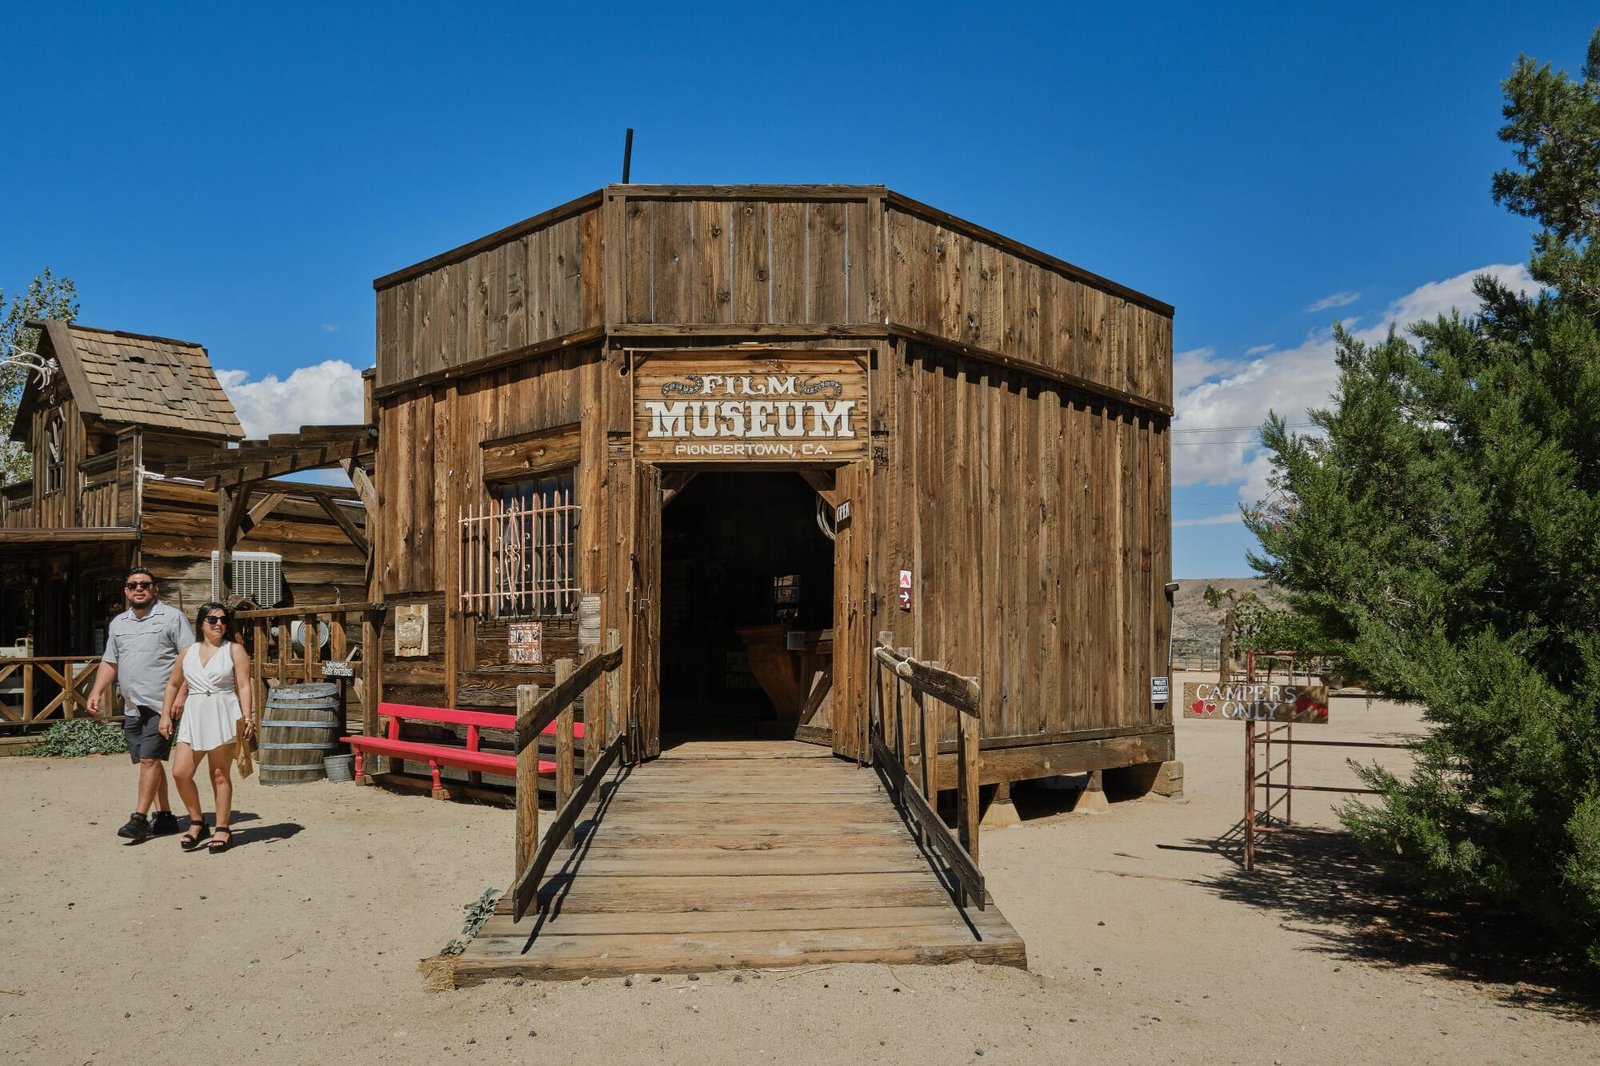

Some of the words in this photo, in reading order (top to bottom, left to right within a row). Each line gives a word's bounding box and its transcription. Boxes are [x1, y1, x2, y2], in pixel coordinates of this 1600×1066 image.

[701, 376, 797, 395] FILM
[645, 401, 856, 438] MUSEUM
[676, 444, 796, 457] PIONEERTOWN,
[802, 444, 832, 455] CA.
[1196, 684, 1296, 703] CAMPERS
[1221, 701, 1281, 720] ONLY
